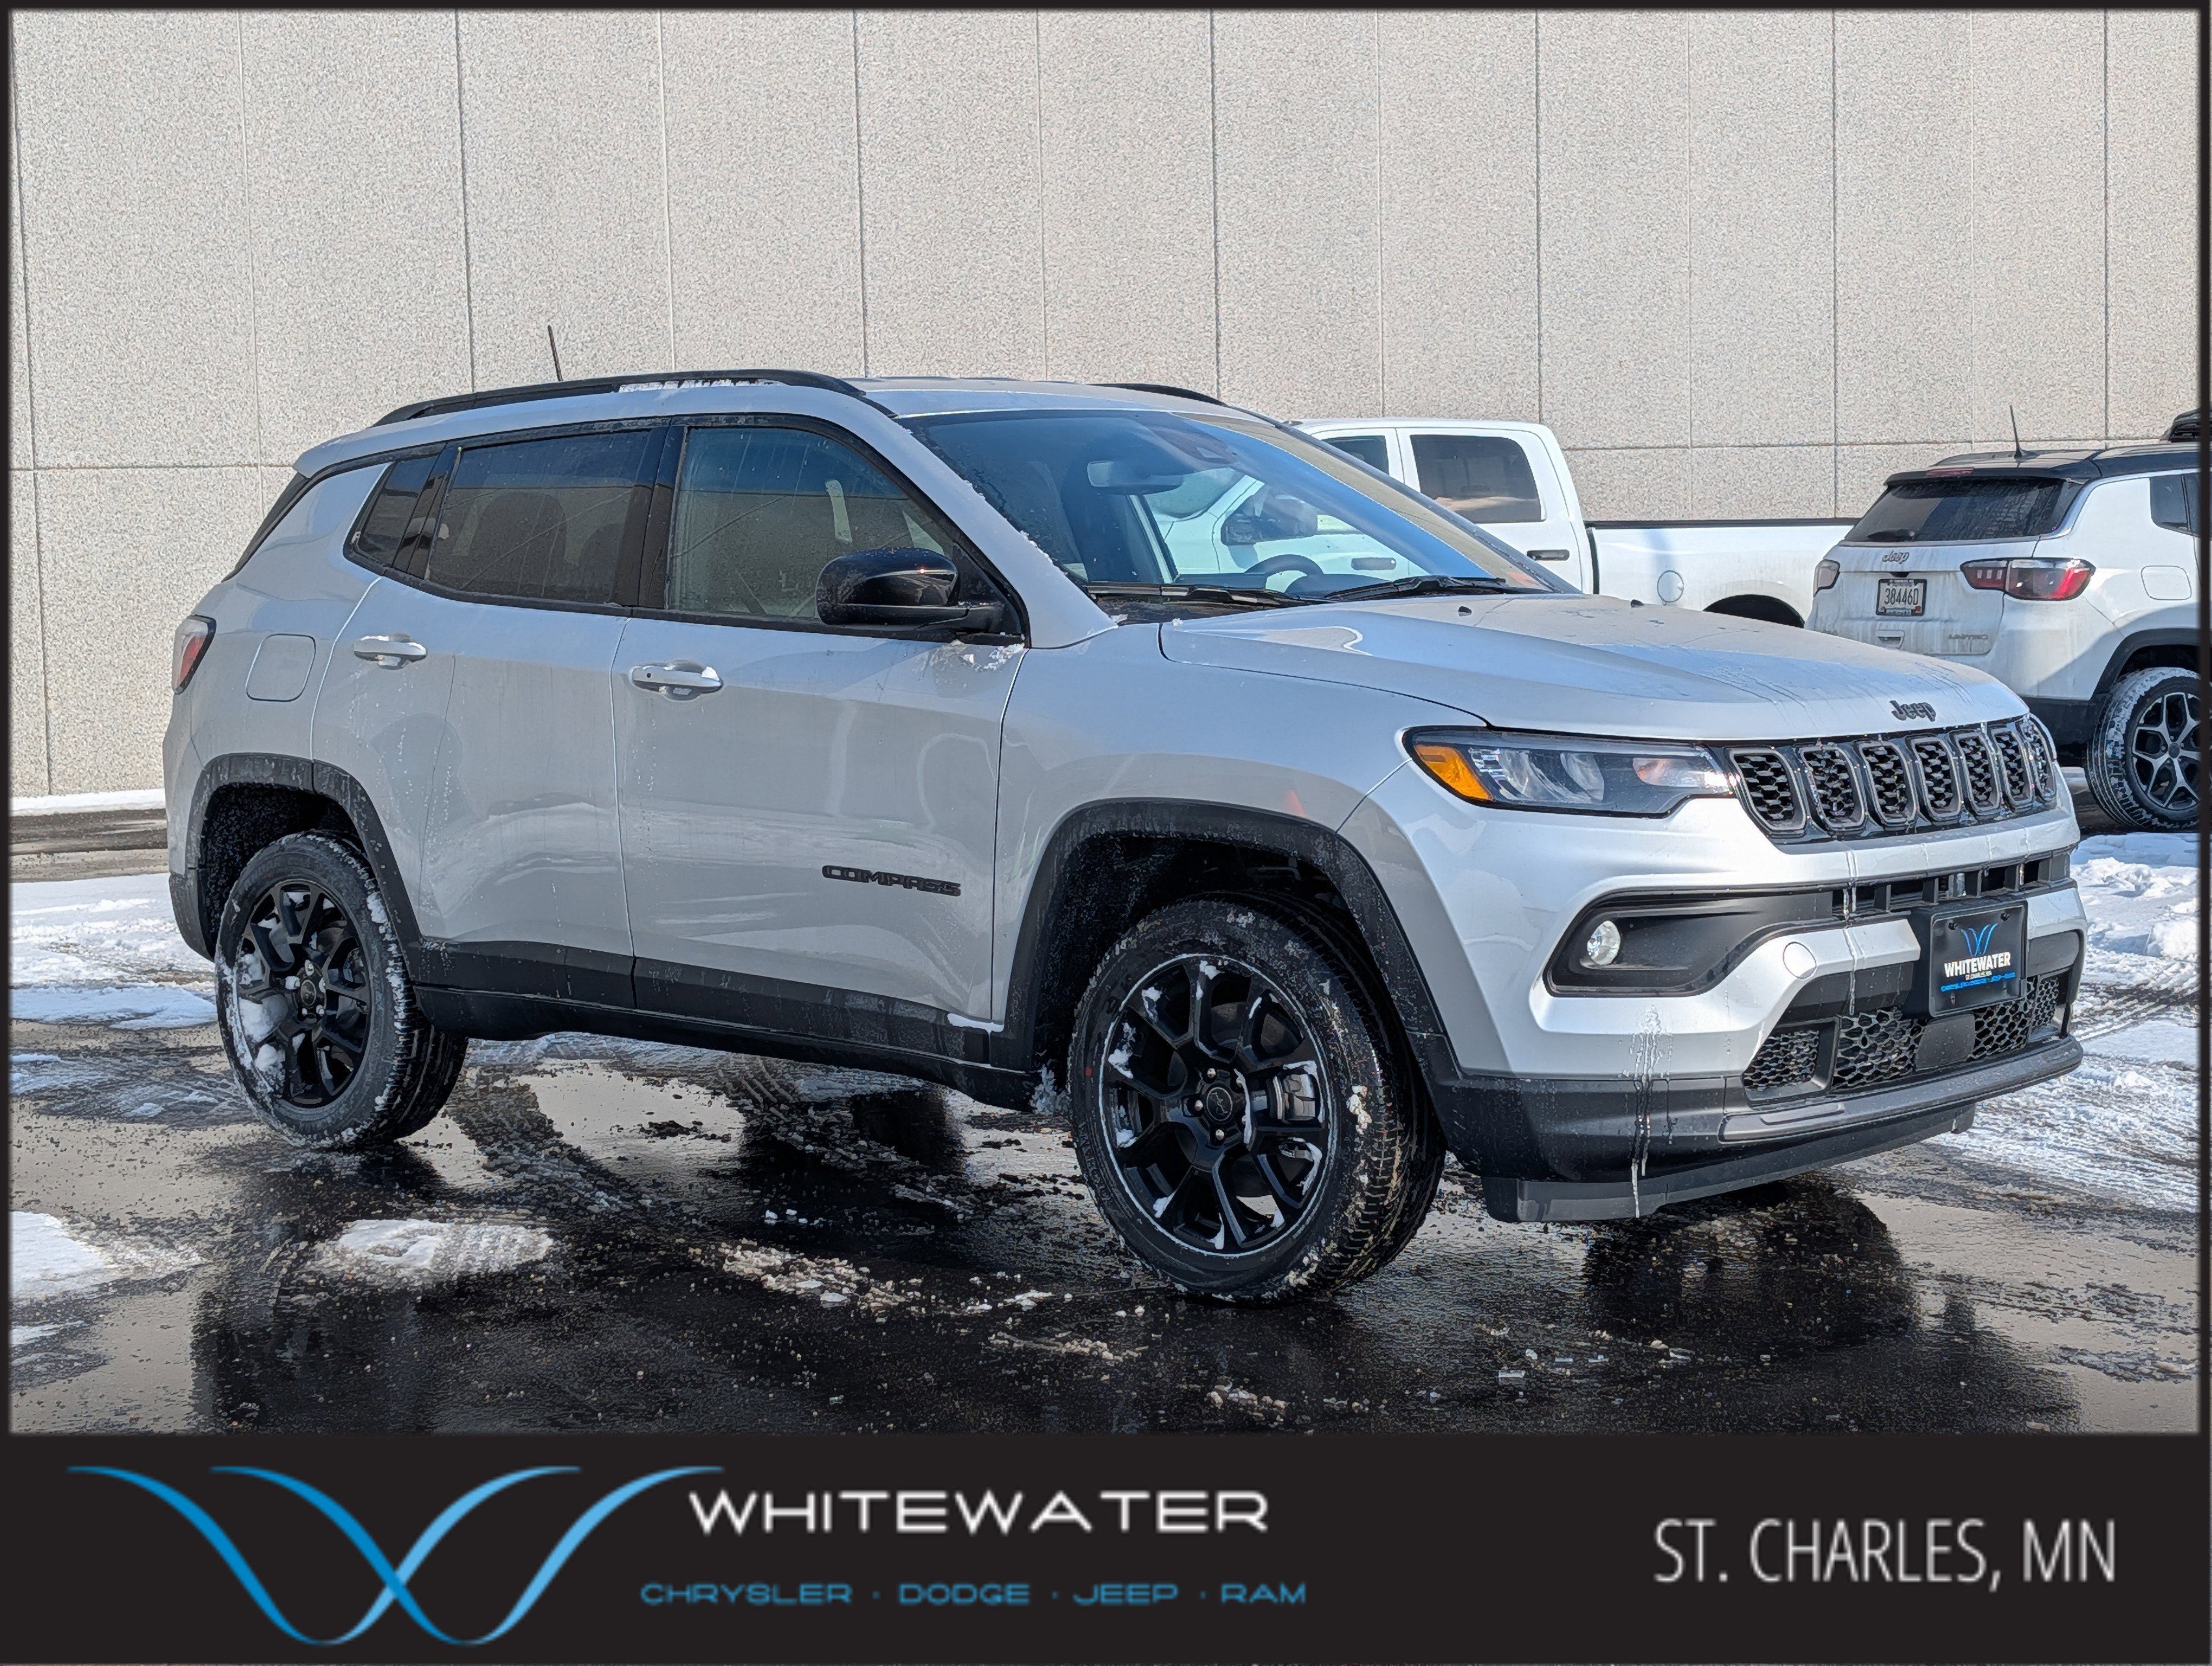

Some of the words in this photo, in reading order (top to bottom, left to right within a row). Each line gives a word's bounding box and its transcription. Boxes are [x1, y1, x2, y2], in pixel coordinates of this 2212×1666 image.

[1889, 700, 1936, 722] Jeep
[822, 865, 961, 896] COMPASS
[1944, 952, 2011, 978] WHITEWATER
